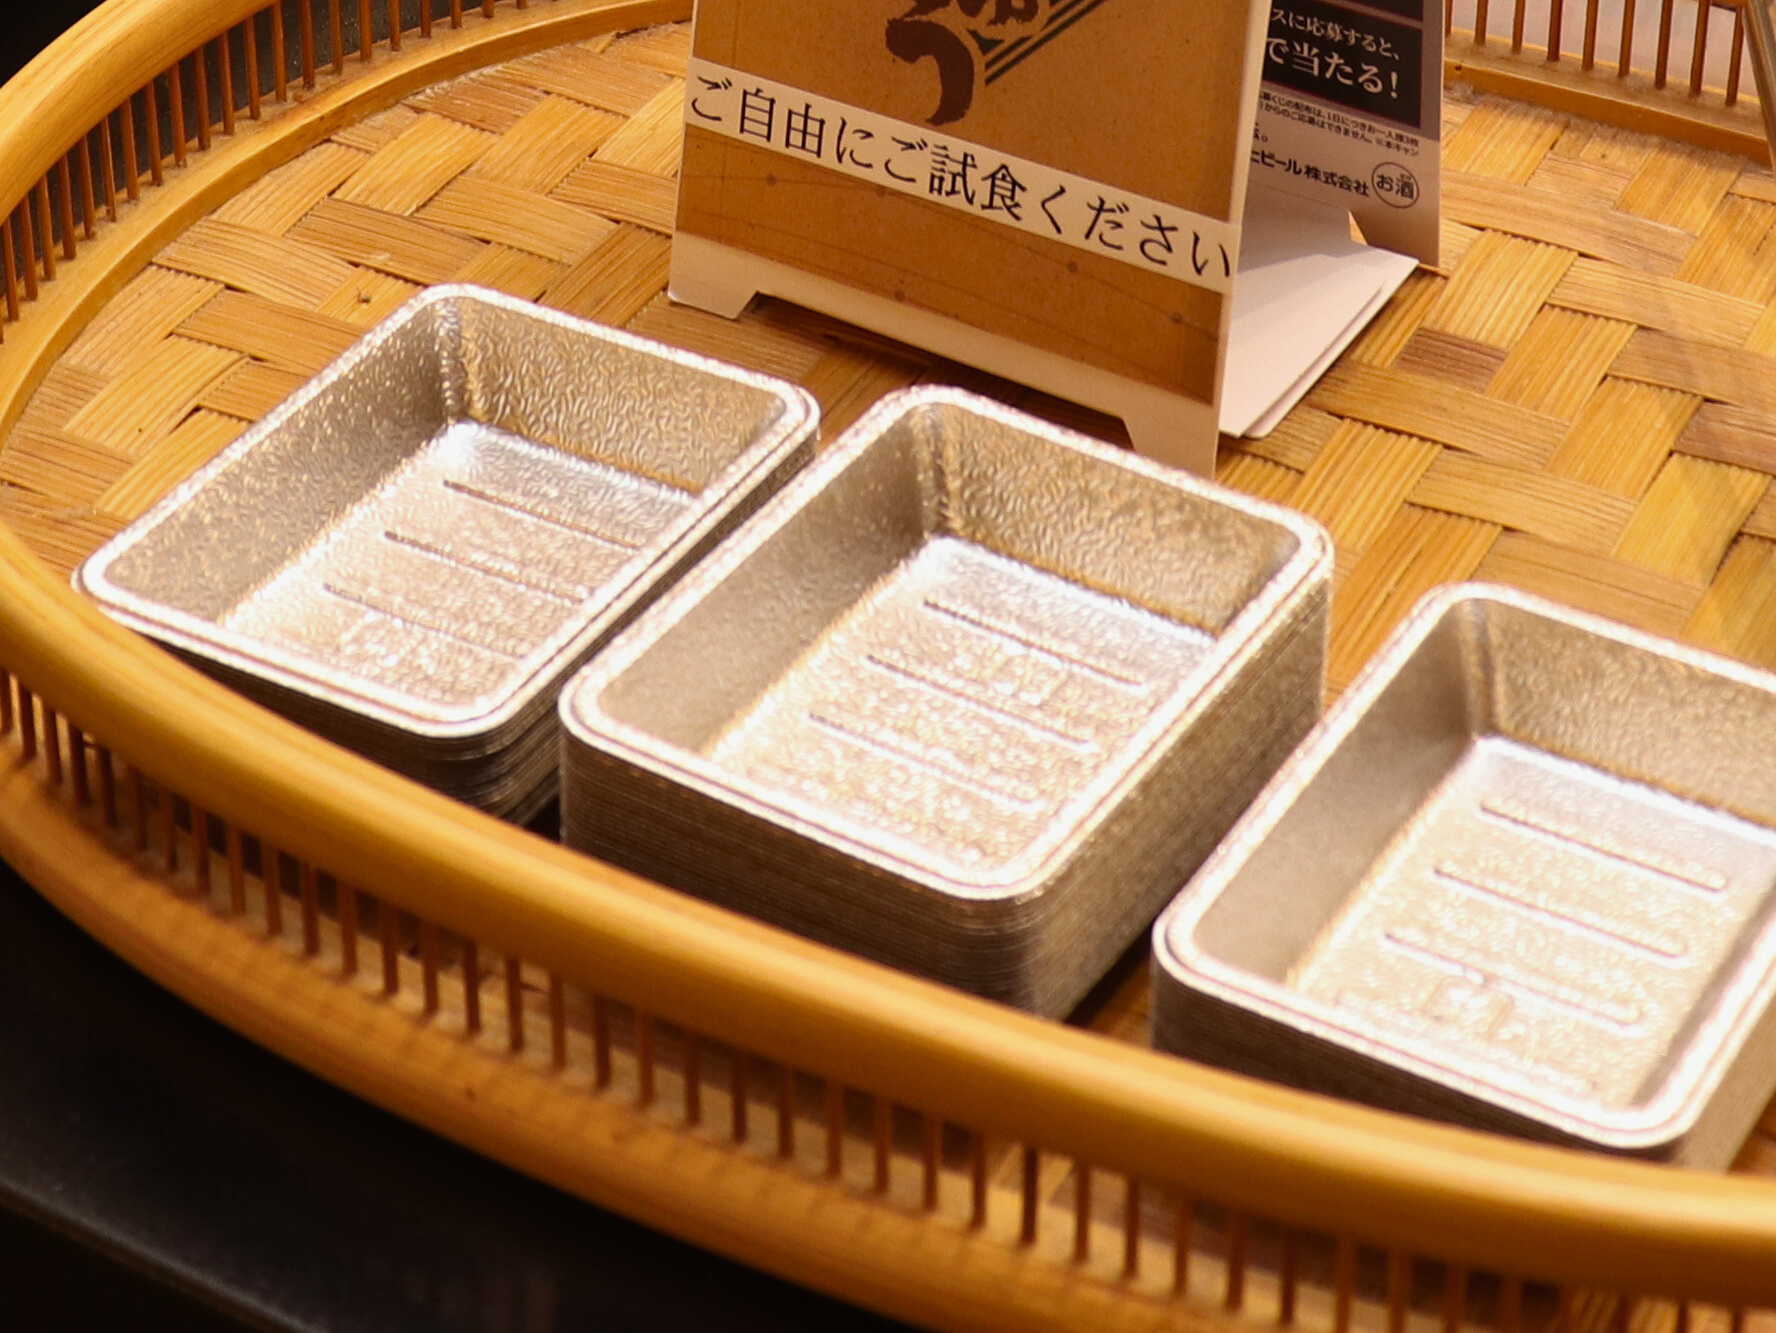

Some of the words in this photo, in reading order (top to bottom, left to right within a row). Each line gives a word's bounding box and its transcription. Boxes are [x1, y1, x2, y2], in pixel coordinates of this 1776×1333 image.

[688, 71, 1235, 282] ご自由にご試食ください
[1376, 172, 1415, 200] お酒
